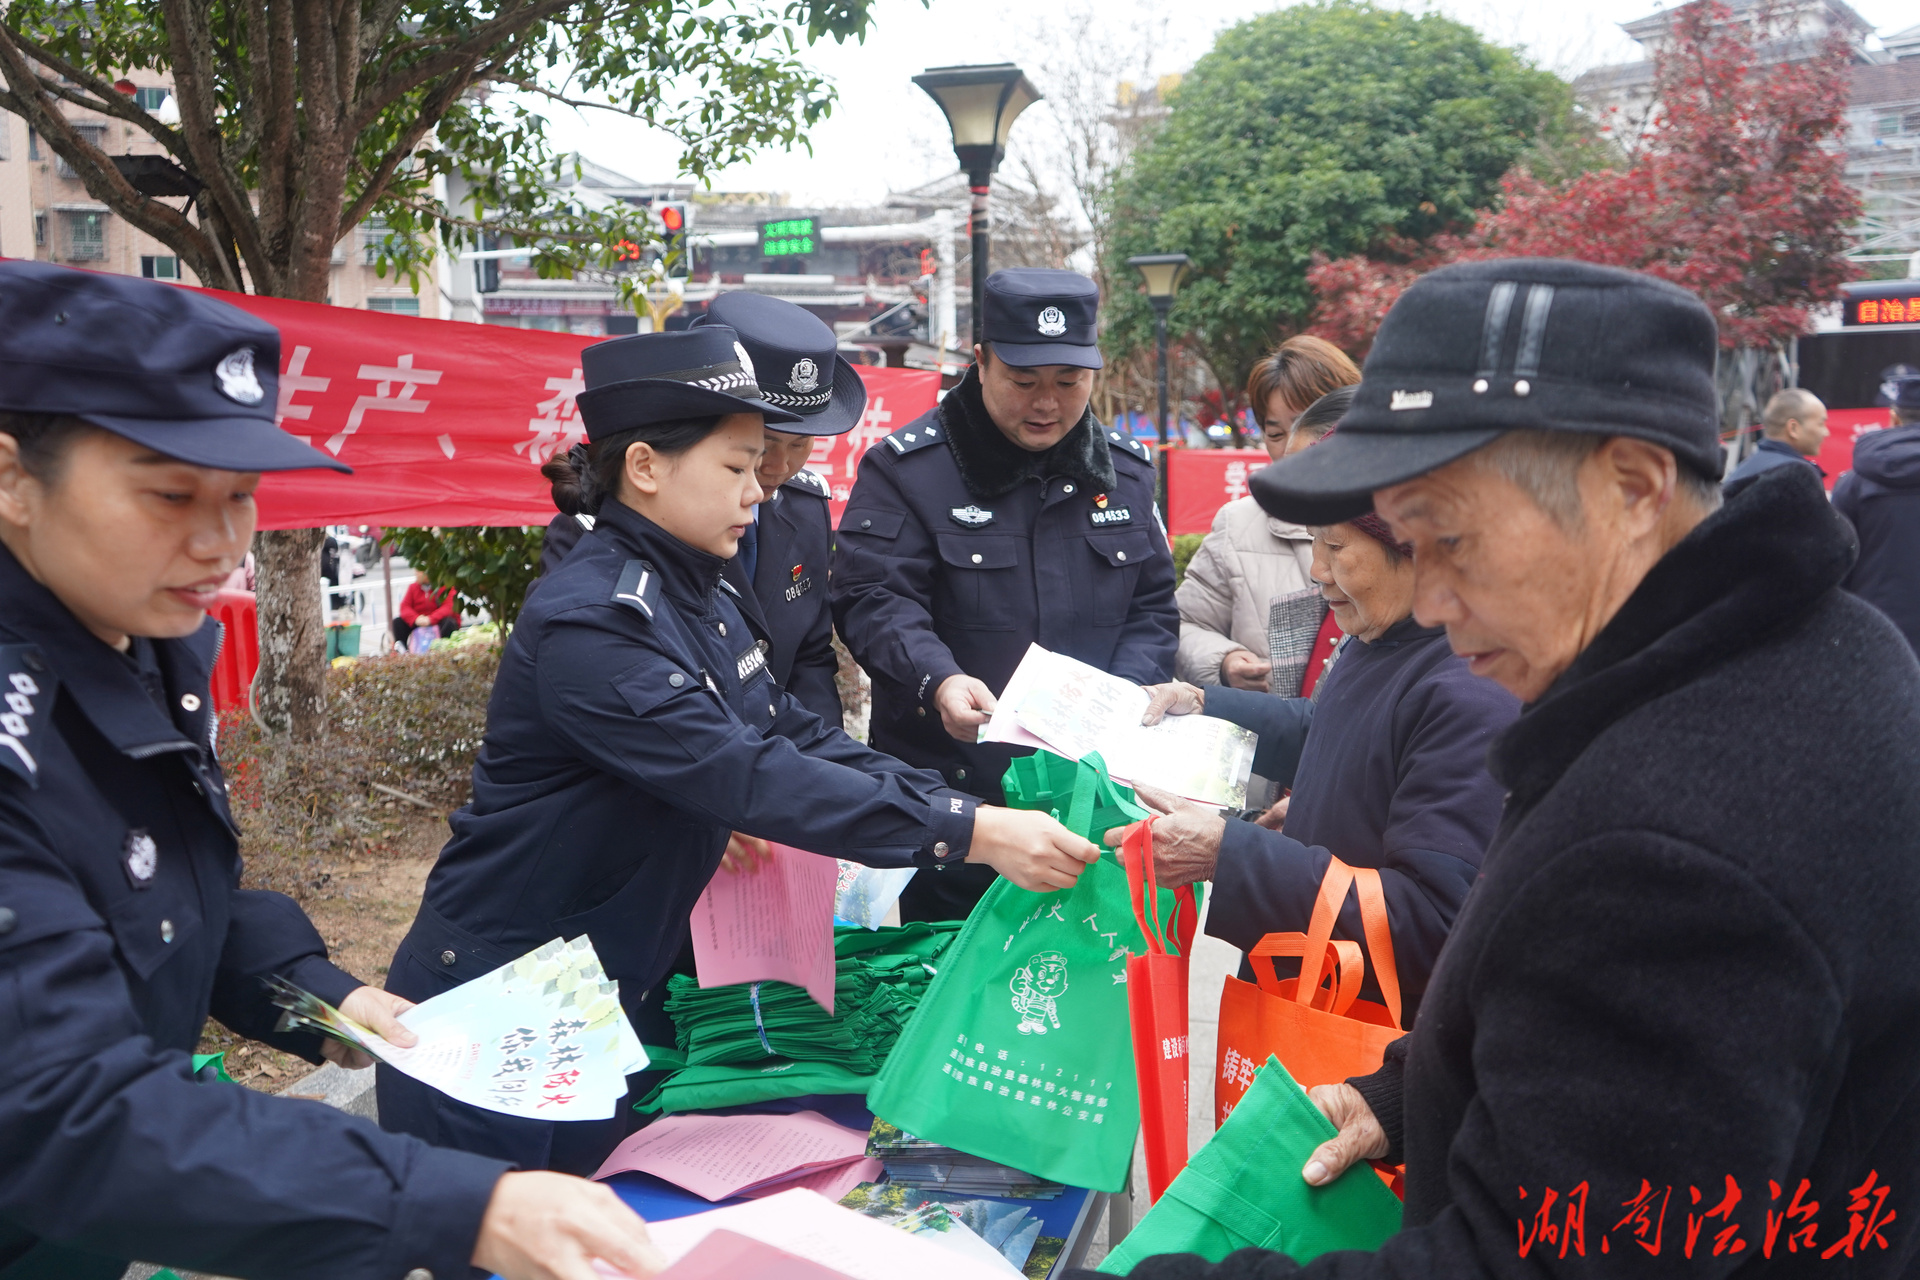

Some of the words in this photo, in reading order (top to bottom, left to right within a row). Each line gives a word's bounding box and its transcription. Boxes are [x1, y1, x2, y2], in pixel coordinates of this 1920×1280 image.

[1091, 509, 1130, 523] 084533
[917, 673, 932, 700] POLICE
[536, 1018, 589, 1109] 森林防火
